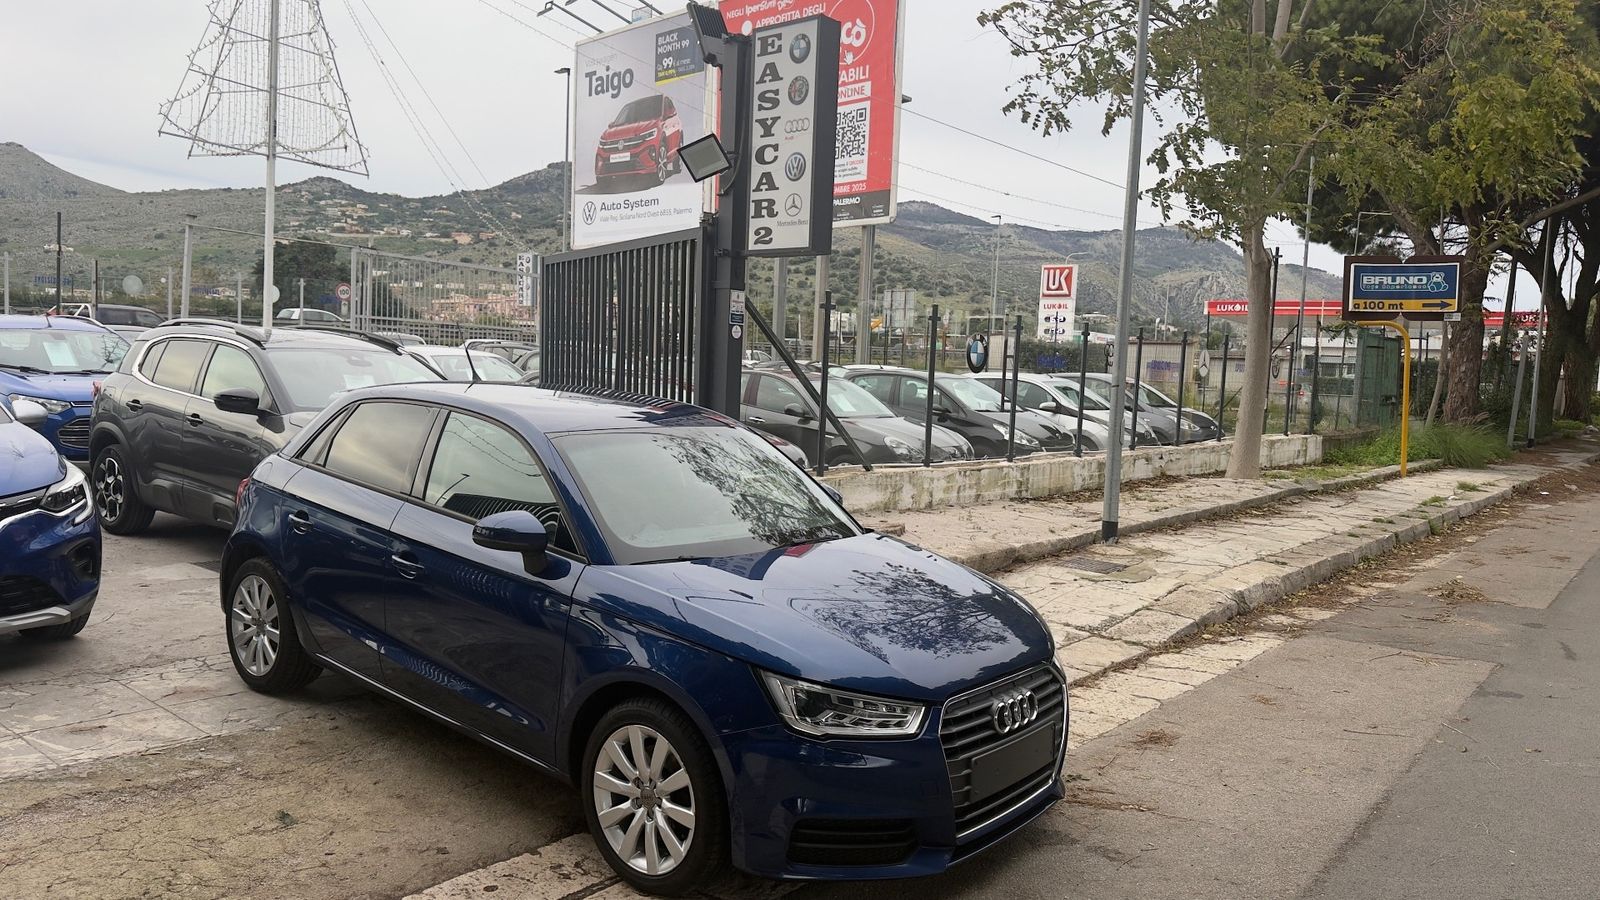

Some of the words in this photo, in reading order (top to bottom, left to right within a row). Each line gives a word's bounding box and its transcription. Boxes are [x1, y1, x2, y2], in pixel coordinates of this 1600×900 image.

[727, 8, 744, 19] NEGLI
[756, 10, 800, 28] APPROFITTA
[803, 4, 826, 17] DEGLI
[658, 32, 678, 45] BLACK
[657, 41, 680, 54] MONTH
[681, 40, 689, 48] 99
[662, 57, 673, 69] 99
[838, 64, 870, 84] ABILI
[585, 65, 634, 98] Taigo
[852, 183, 867, 192] 2025
[600, 202, 621, 211] Auto
[623, 197, 659, 211] System
[1363, 276, 1427, 285] BRUNO
[1216, 304, 1249, 312] LUKOIL
[1363, 301, 1385, 309] 100
